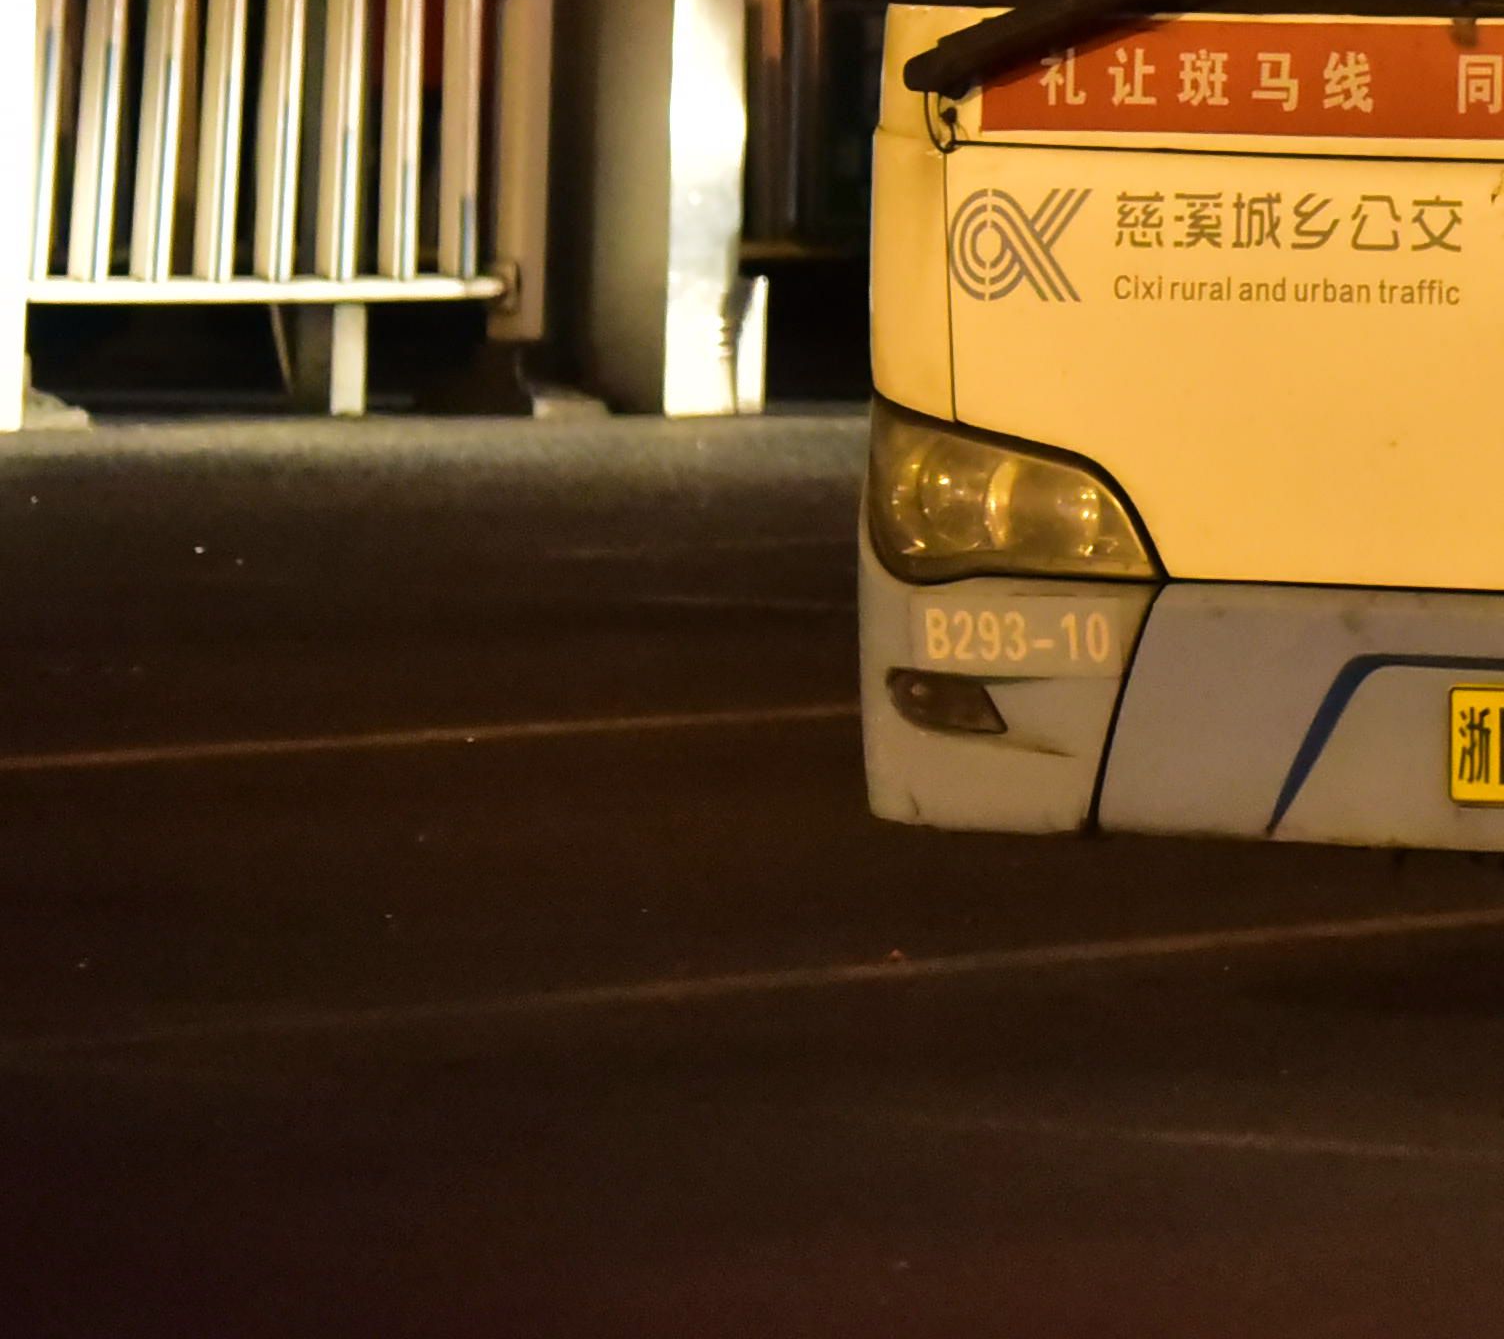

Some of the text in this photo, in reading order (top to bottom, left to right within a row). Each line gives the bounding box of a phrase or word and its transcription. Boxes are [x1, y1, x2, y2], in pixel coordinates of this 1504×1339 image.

[1038, 47, 1374, 114] 礼让斑马线
[1114, 190, 1464, 253] 慈溪城乡公交
[1113, 274, 1461, 307] Cixi rural and urban traffic
[925, 608, 1110, 664] B293-10
